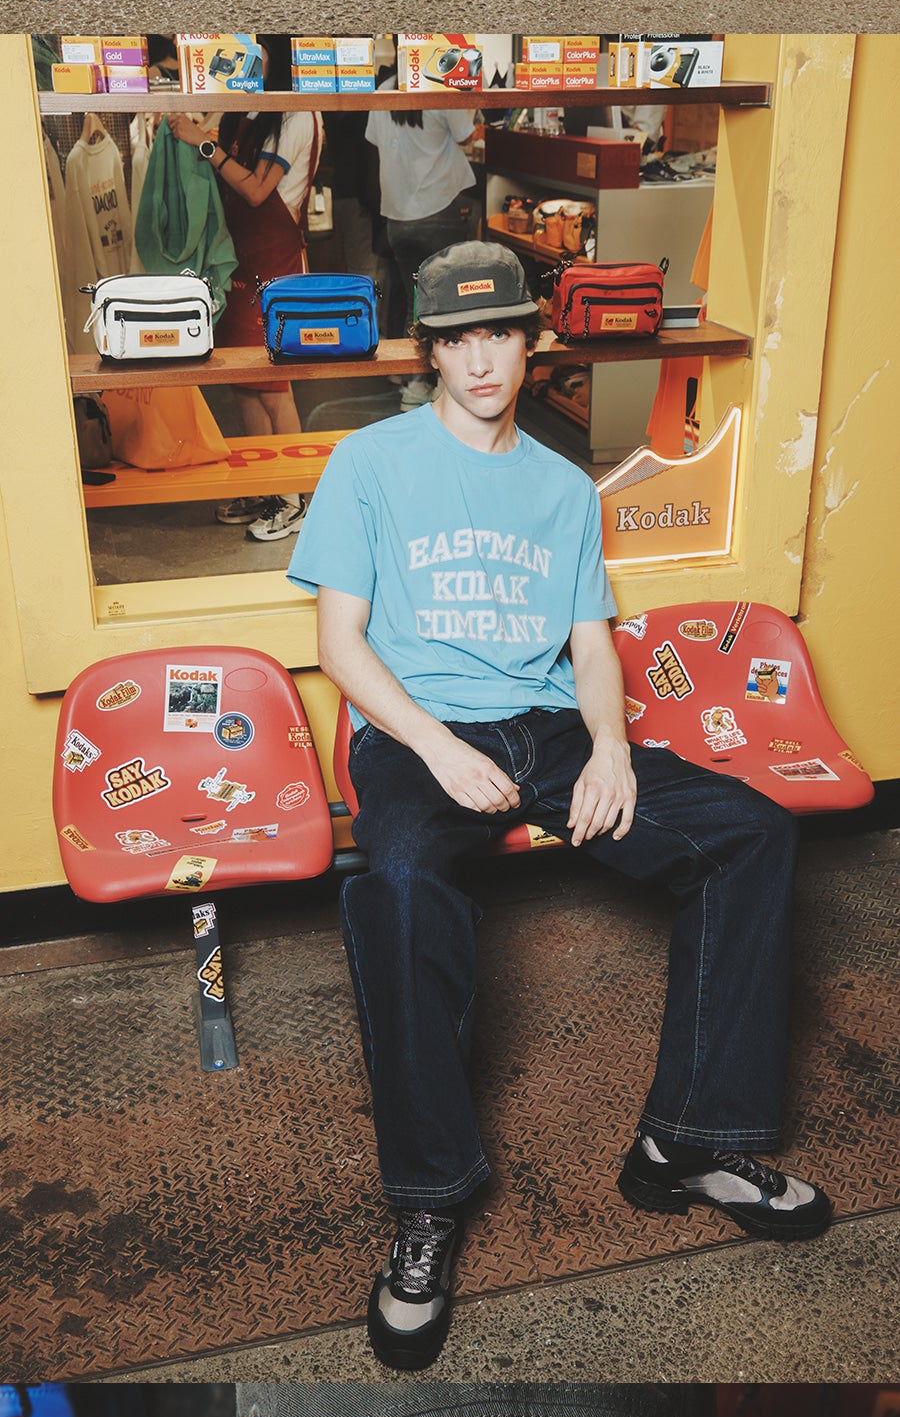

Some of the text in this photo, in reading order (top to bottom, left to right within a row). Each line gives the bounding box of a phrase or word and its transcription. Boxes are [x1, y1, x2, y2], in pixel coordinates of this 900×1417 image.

[105, 51, 122, 61] Gold
[299, 52, 331, 61] UltraMax
[566, 51, 597, 60] ColorPlus
[193, 48, 206, 91] Kodak
[409, 48, 420, 89] Kodak
[110, 79, 128, 89] Gold
[231, 80, 259, 90] Daylight
[301, 79, 333, 88] UltraMax
[341, 79, 372, 88] UltraMax
[448, 78, 479, 87] FunSaver
[531, 77, 560, 86] ColorPlus
[565, 77, 594, 86] ColorPlus
[469, 282, 492, 291] Kodak
[616, 500, 711, 533] Kodak
[407, 527, 553, 579] EASTMAN
[414, 608, 549, 644] COMPANY
[682, 624, 714, 635] Kodak Film
[169, 669, 218, 682] Kodak
[657, 644, 692, 698] KODAK
[649, 668, 673, 697] SAY
[100, 686, 137, 708] Kodak Film
[109, 760, 141, 789] SAY
[105, 770, 167, 807] KODAK
